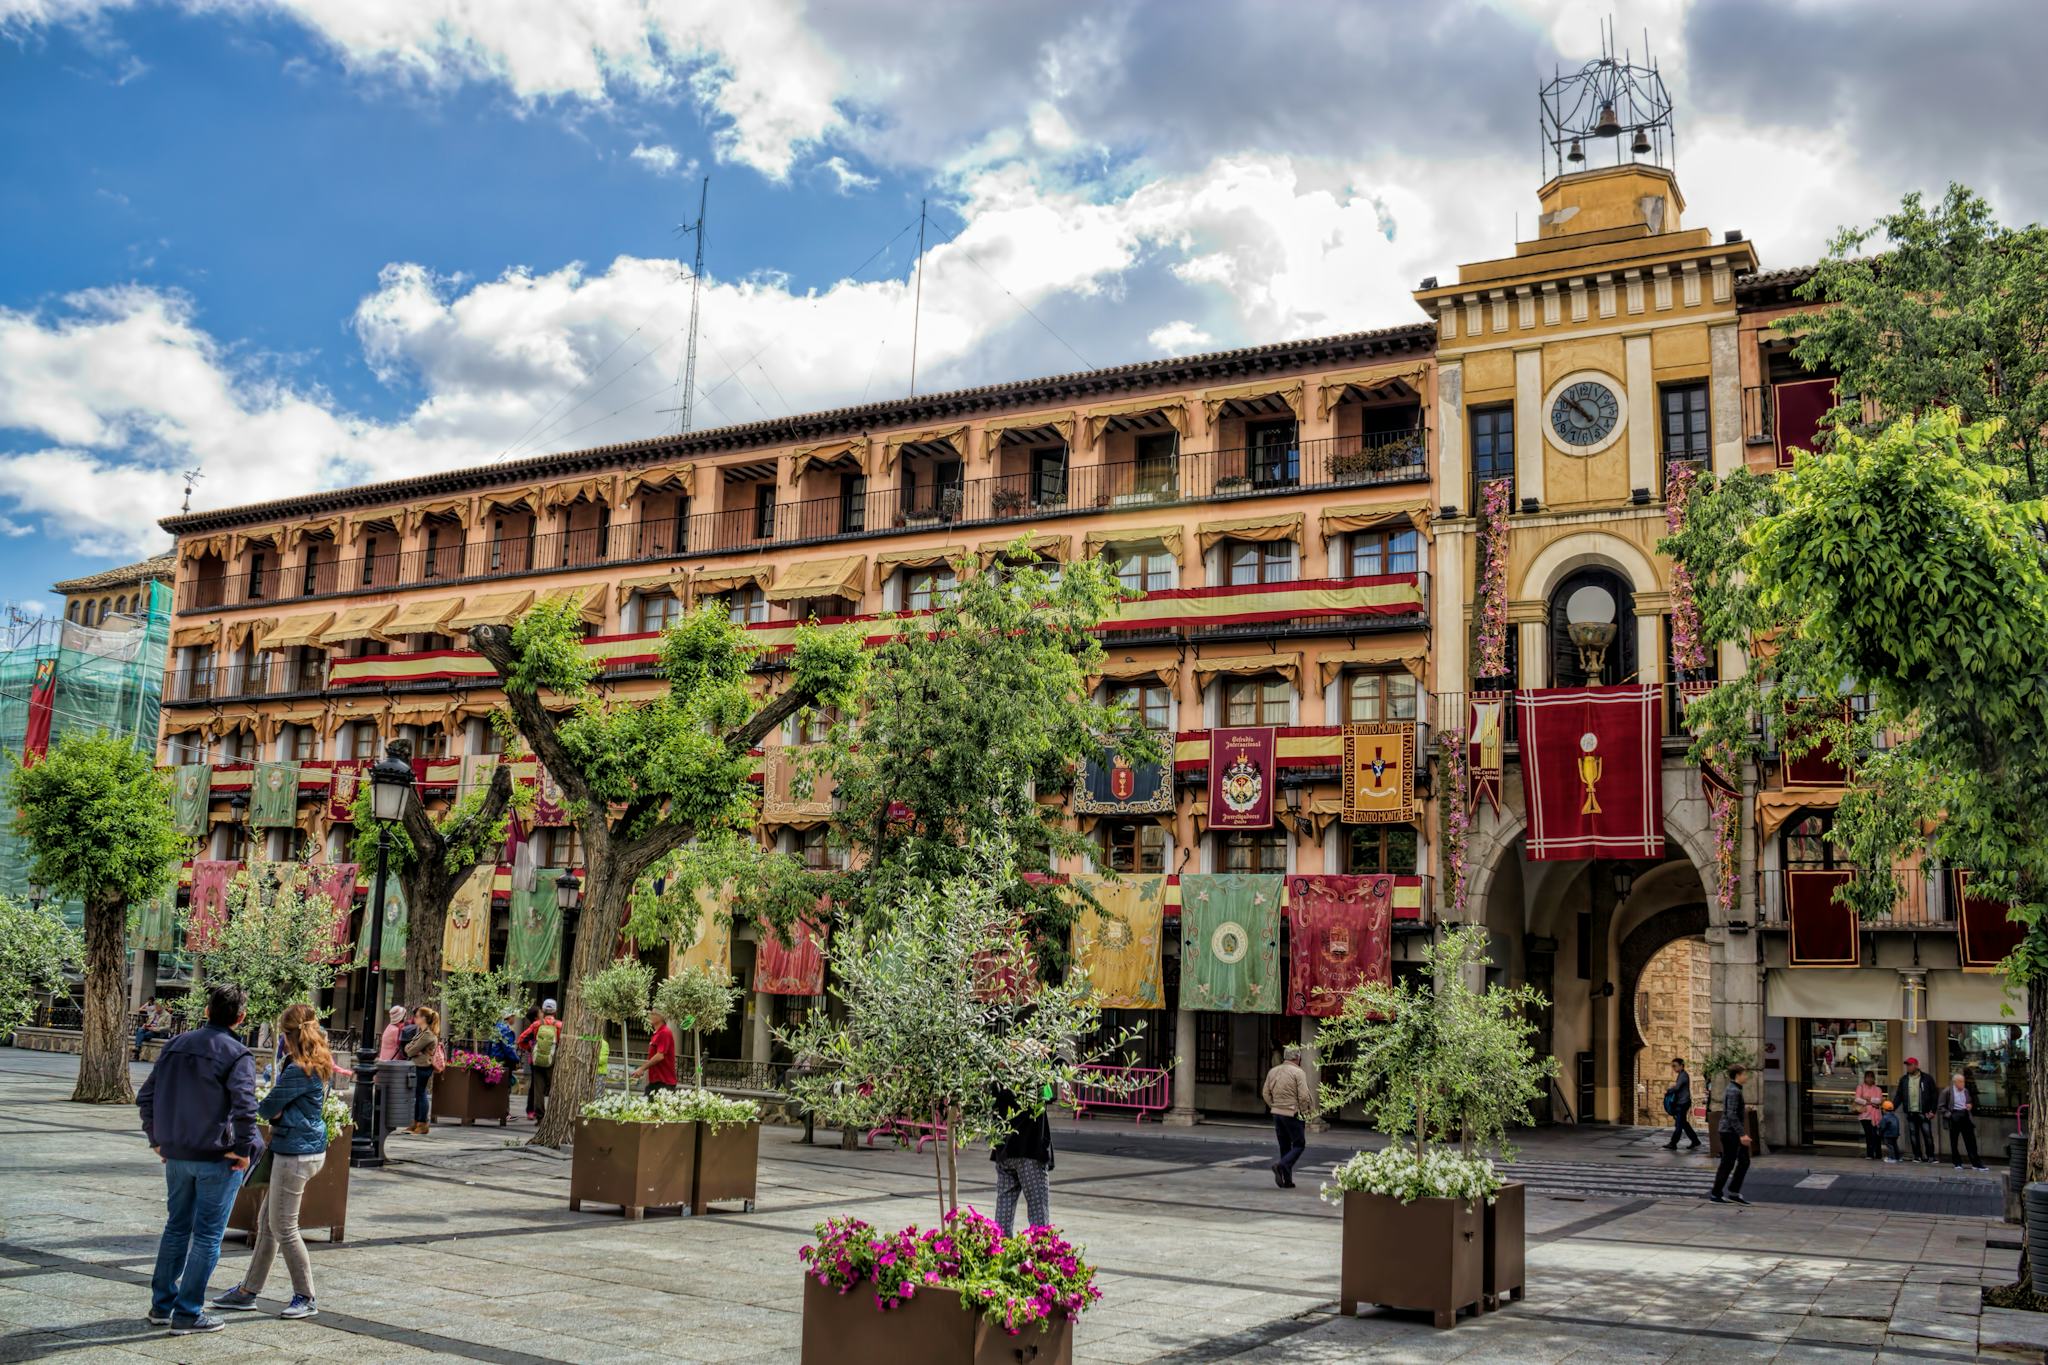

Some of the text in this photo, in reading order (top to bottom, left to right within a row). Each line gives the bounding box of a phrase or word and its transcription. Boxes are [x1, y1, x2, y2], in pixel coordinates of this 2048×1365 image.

[1579, 385, 1589, 397] 12
[1560, 400, 1569, 410] 10
[1603, 394, 1610, 405] 2
[1609, 406, 1615, 416] 3
[1555, 412, 1562, 422] 9
[1560, 423, 1566, 434] 8
[1603, 418, 1610, 429] 4
[1570, 431, 1577, 441] 7
[1583, 433, 1588, 442] 6
[1594, 428, 1601, 438] 5
[1356, 723, 1401, 735] TANTO MONTA
[1345, 739, 1354, 808] TANTO MONTA
[1403, 736, 1413, 807] TANTO MONTA
[1356, 811, 1401, 822] TANTO MONTA
